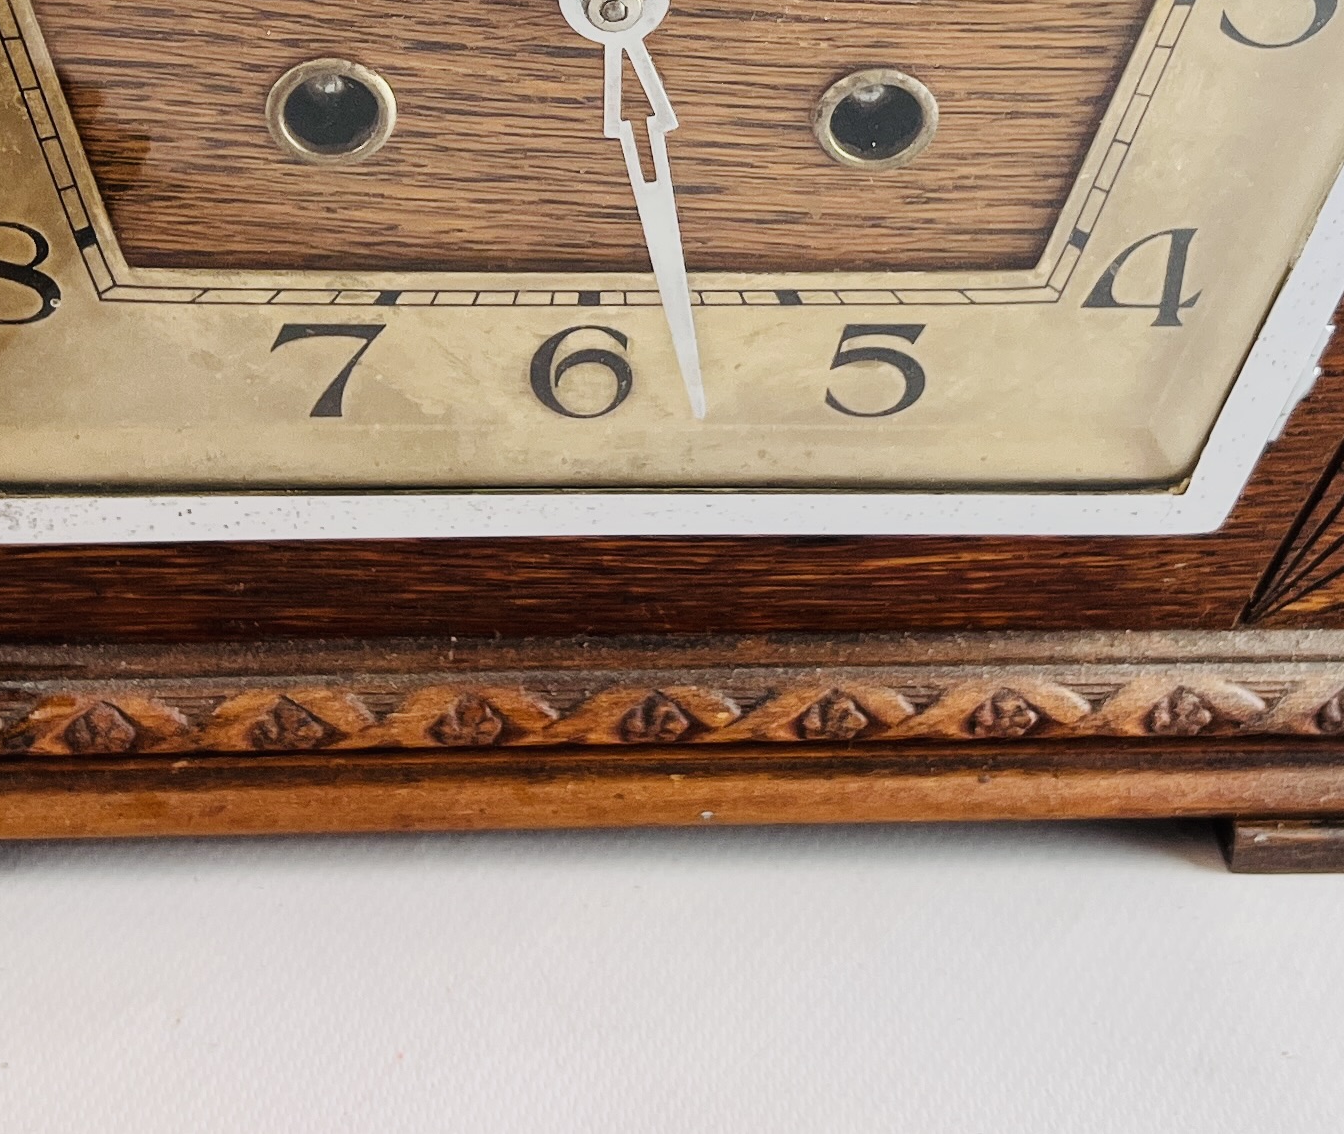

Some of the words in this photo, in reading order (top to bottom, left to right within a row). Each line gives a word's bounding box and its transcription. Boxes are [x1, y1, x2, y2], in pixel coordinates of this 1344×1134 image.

[1080, 228, 1199, 327] 4
[270, 323, 386, 417] 7
[529, 324, 633, 418] 6
[825, 324, 926, 418] 5
